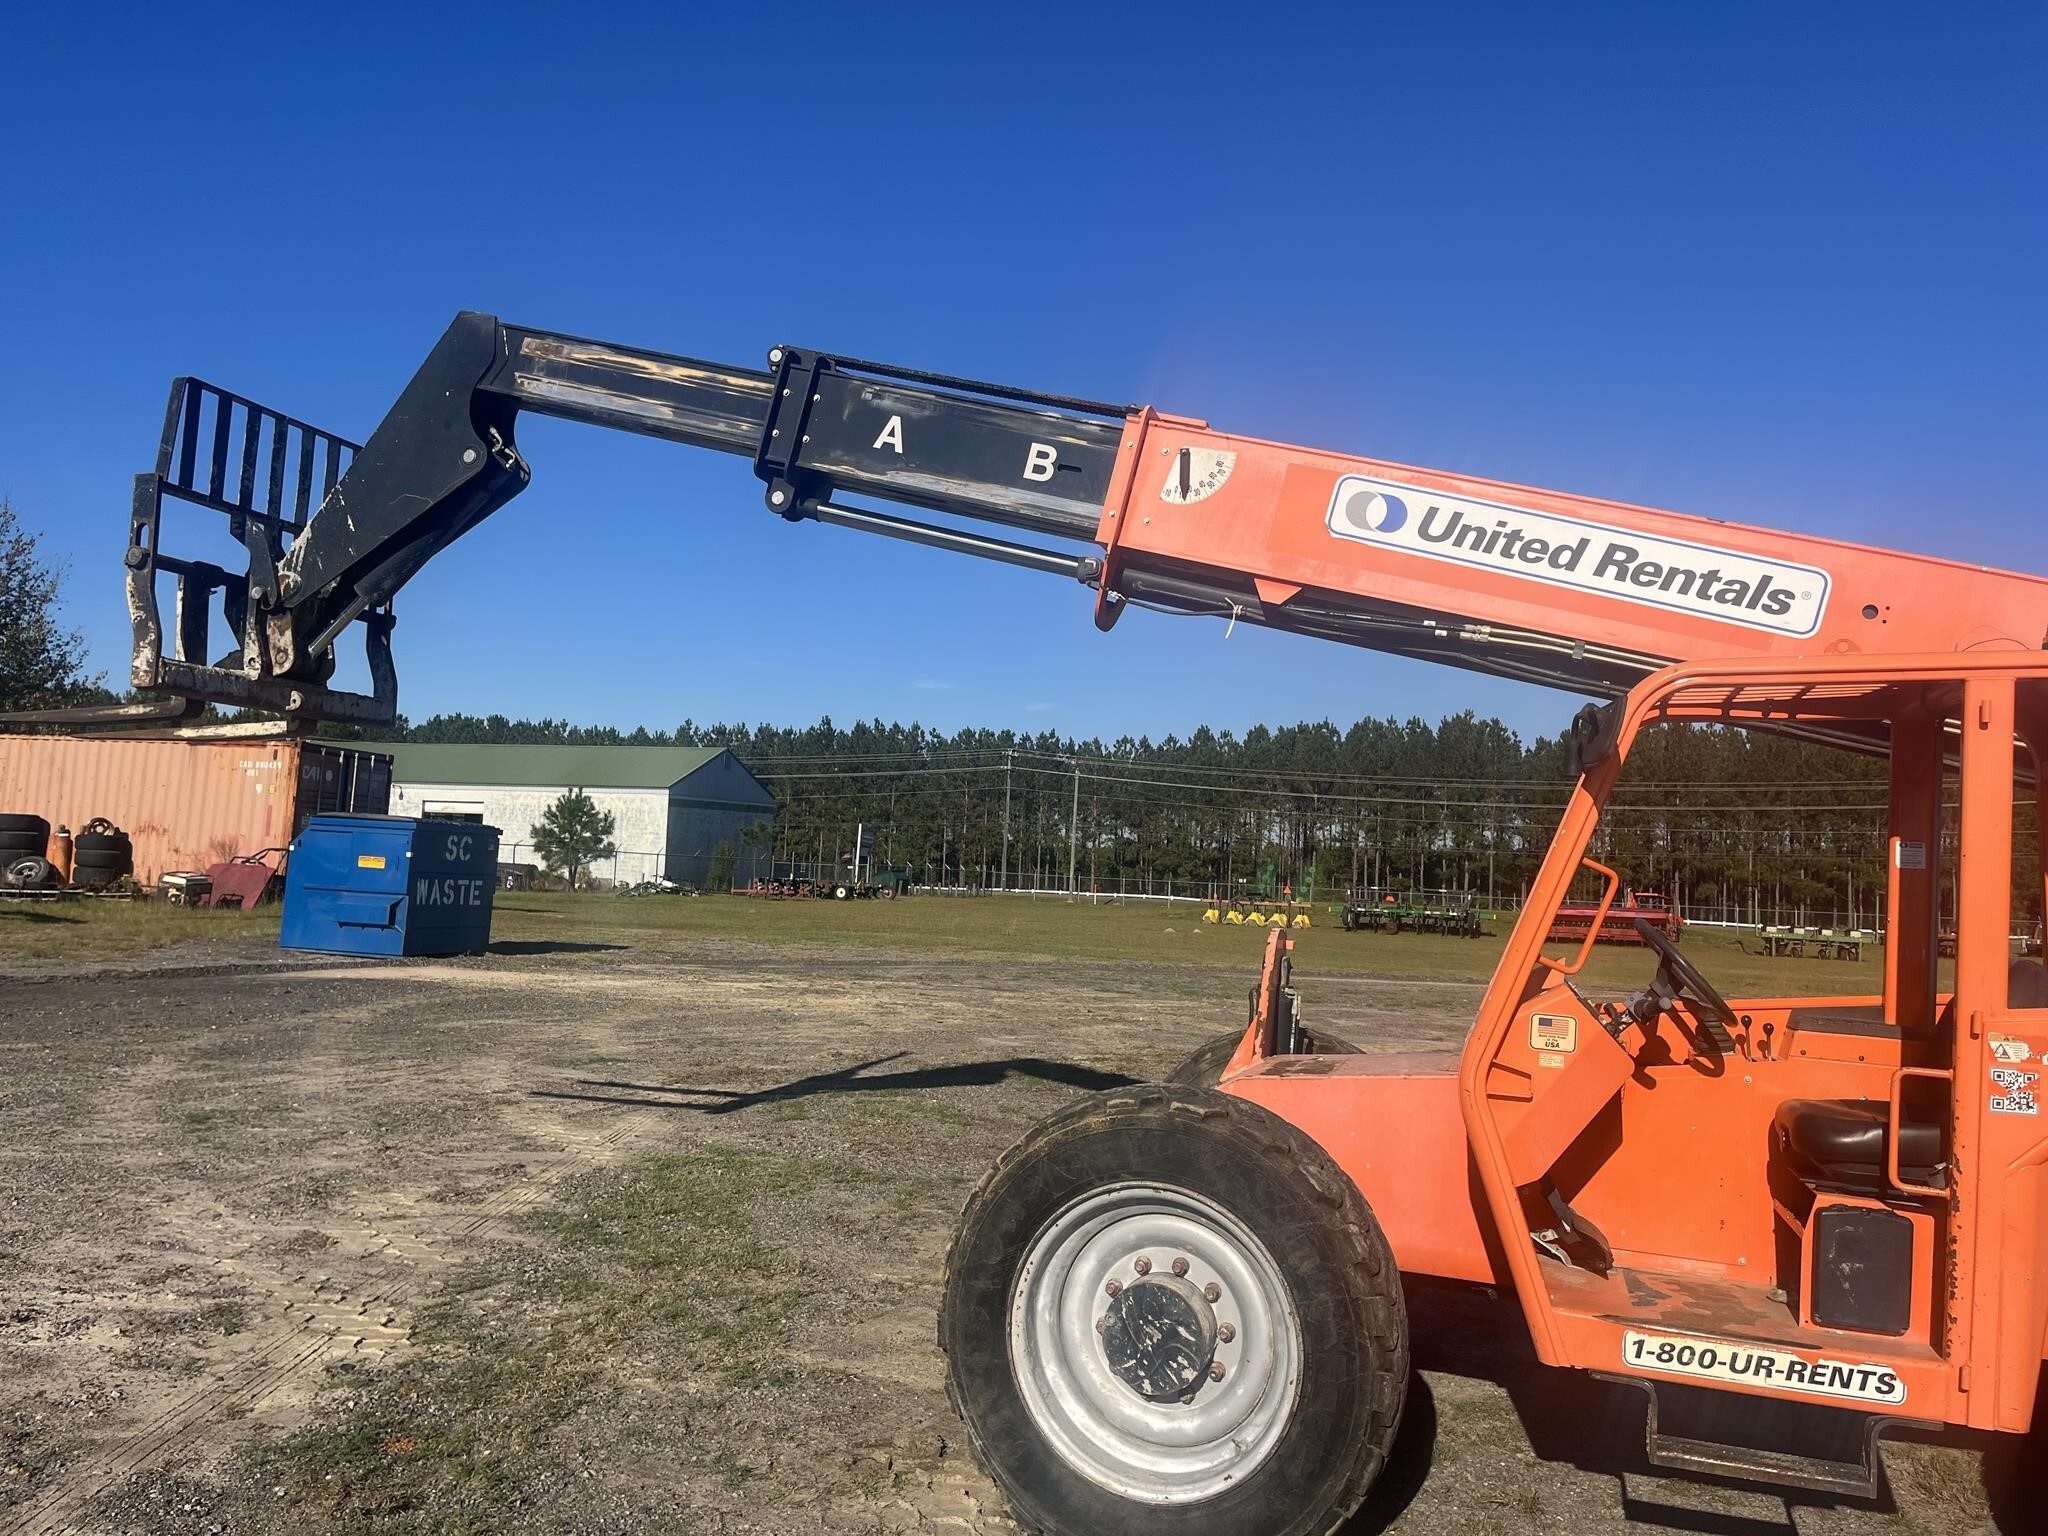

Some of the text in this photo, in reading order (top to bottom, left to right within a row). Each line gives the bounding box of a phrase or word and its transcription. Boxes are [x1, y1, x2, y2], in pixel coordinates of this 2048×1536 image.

[872, 414, 904, 454] A
[1022, 442, 1058, 482] B
[1416, 505, 1797, 616] United Rentals
[445, 834, 473, 861] SC
[416, 878, 483, 906] WASTE
[1545, 1041, 1560, 1049] USA
[1632, 1338, 1897, 1396] 1-800-UR-RENTS
